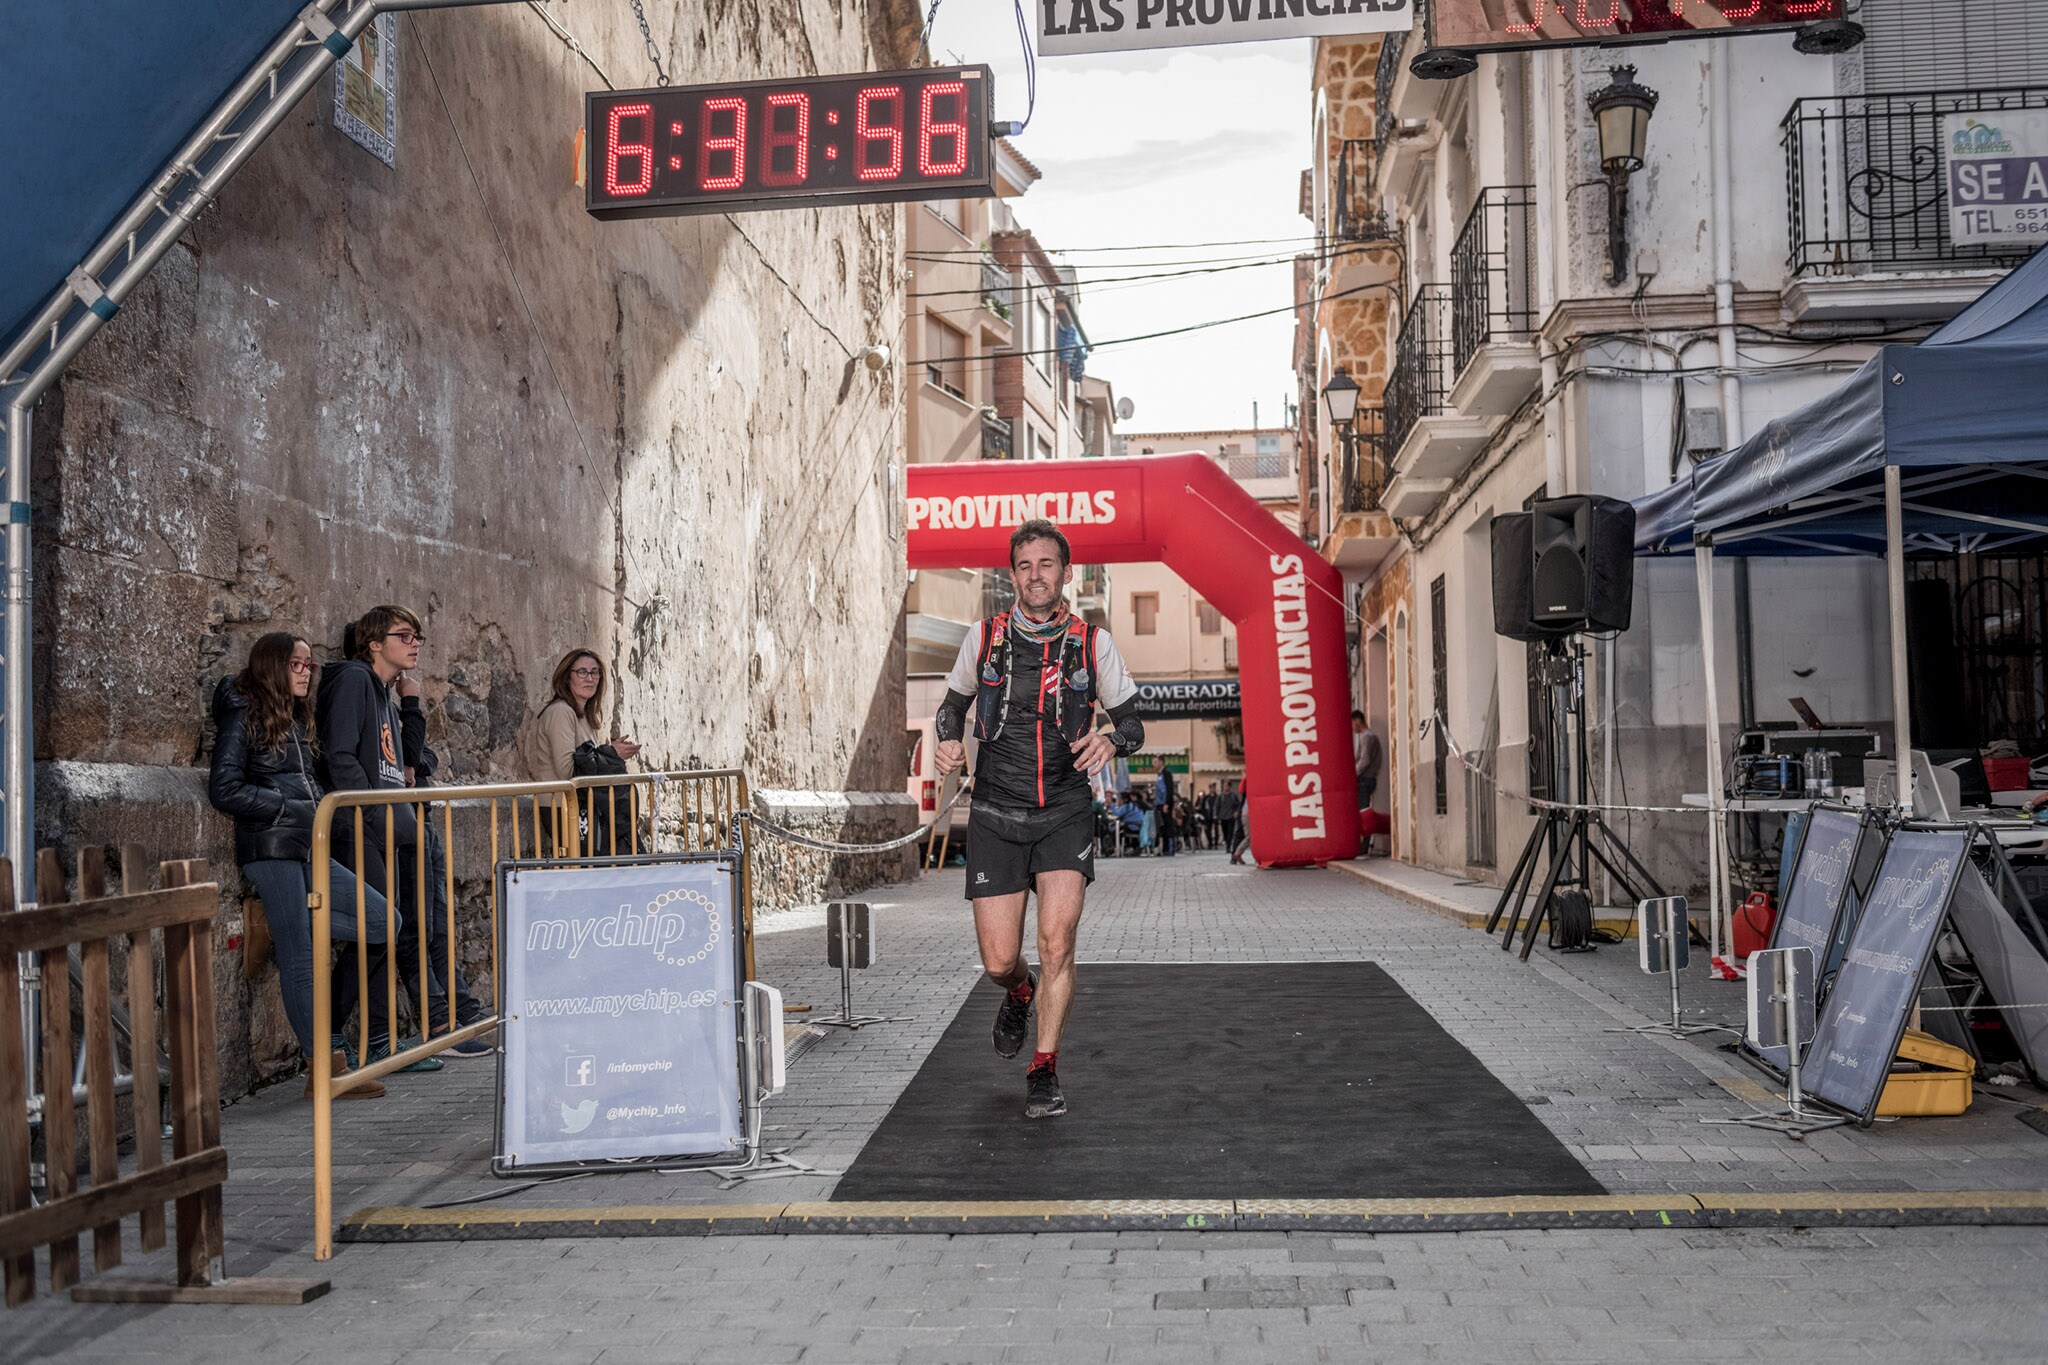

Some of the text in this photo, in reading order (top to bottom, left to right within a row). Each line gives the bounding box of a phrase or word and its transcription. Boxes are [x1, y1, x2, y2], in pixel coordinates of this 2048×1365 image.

[1044, 0, 1407, 36] LAS PROVIN
[606, 82, 968, 196] 6:37:56
[1958, 163, 2004, 201] SE
[906, 490, 1116, 530] PROVINCIAS
[1137, 684, 1237, 699] OWERADE
[1163, 702, 1185, 713] para
[1270, 554, 1327, 840] LAS PROVINCIAS
[527, 904, 685, 959] mychip
[525, 988, 717, 1018] www.mychip.es
[607, 1060, 672, 1074] /infomychip
[607, 1104, 686, 1120] @Mychip_Info
